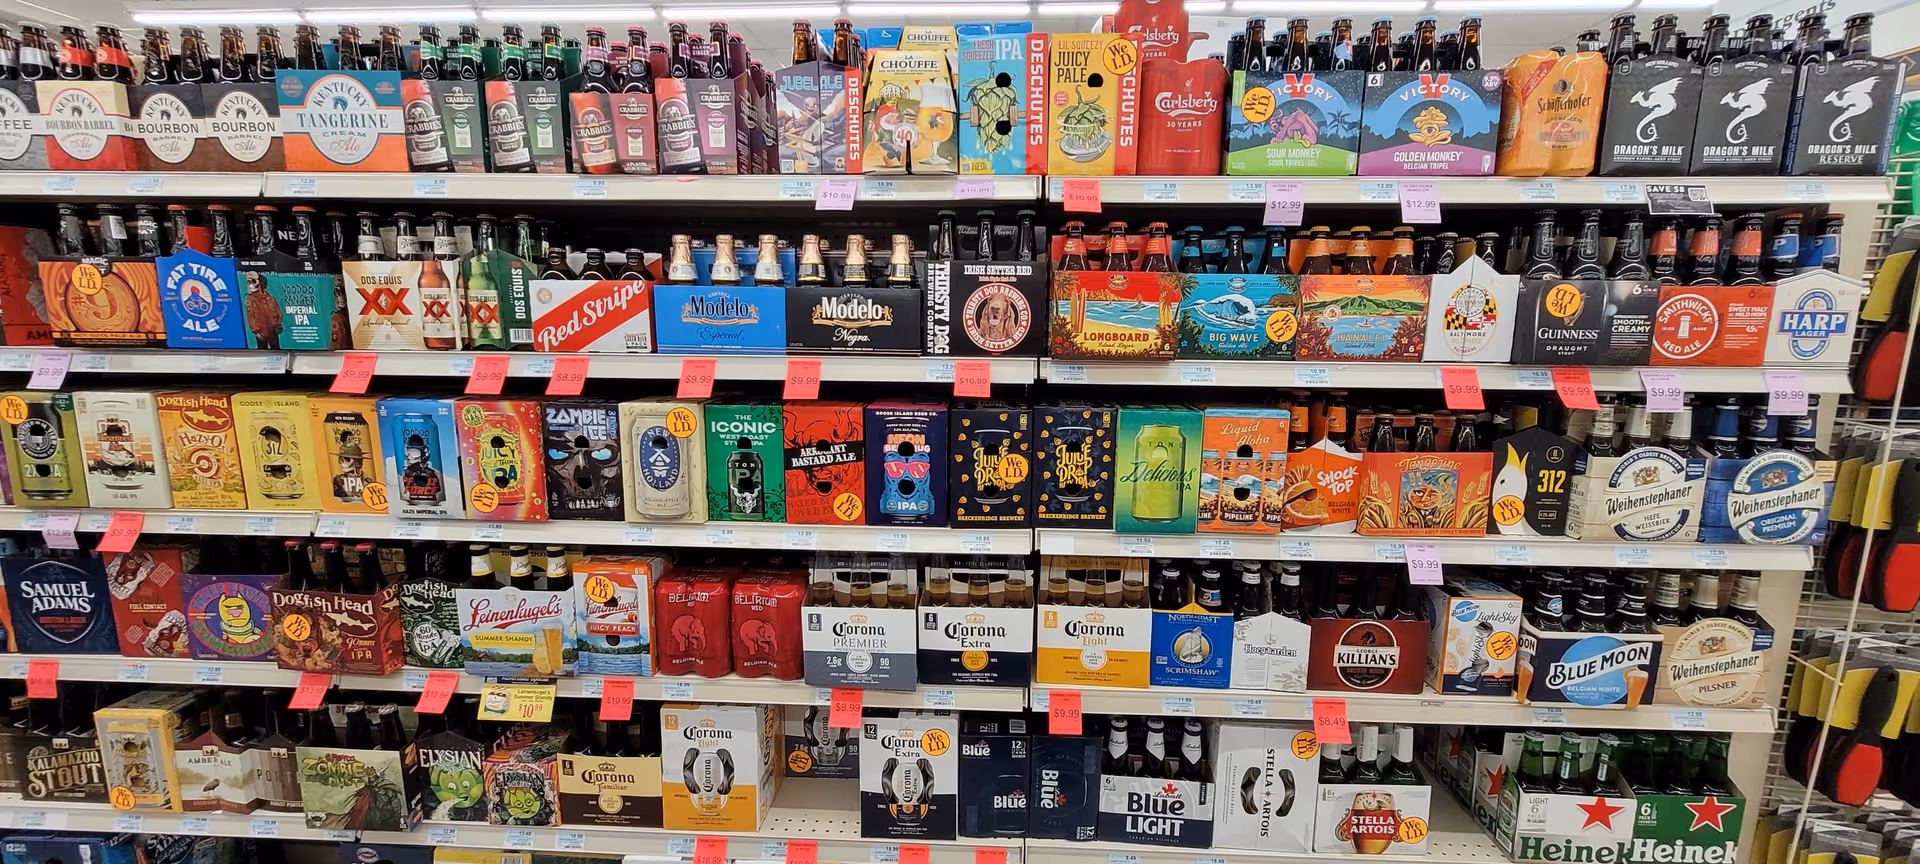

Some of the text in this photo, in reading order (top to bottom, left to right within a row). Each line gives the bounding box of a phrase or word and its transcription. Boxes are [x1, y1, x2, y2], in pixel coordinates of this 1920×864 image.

[907, 33, 950, 41] CHOUFFE
[973, 40, 994, 49] FRESH
[995, 39, 1023, 60] IPA
[1059, 40, 1103, 50] LIL SQUEEZY
[1108, 42, 1128, 56] We
[963, 50, 994, 61] SQUEEZED
[1054, 52, 1090, 67] JUICY
[881, 61, 938, 69] CHOUFFE
[1057, 67, 1086, 83] PALE
[780, 75, 842, 90] JUBEL ALE
[313, 81, 370, 108] KENTUCKY
[1031, 39, 1044, 145] DESCHUTES
[1399, 84, 1471, 102] VICTORY
[1155, 92, 1218, 112] Carlsberg
[296, 112, 388, 128] TANGERINE
[849, 77, 860, 160] DESCHUTES
[45, 120, 115, 130] BOURBON BARREL
[138, 123, 199, 133] BOURBON
[212, 122, 275, 132] BOURBON
[1614, 145, 1684, 154] DRAGON'S MILK
[1703, 146, 1774, 156] DRAGON'S MILK
[1808, 144, 1878, 154] DRAGON'S MILK
[1394, 151, 1463, 162] GOLDEN MONKEY
[1819, 155, 1864, 164] RESERVE
[822, 191, 851, 199] $10.99
[1271, 200, 1300, 210] $12.99
[1406, 200, 1436, 208] $12.99
[81, 258, 109, 266] MAGIC
[80, 268, 95, 279] We
[964, 266, 986, 276] IRISH
[987, 266, 1014, 276] SETTER
[166, 263, 227, 292] FAT TIRE
[361, 275, 403, 285] DOS EQUIS
[282, 284, 314, 295] VOODOO
[284, 295, 316, 305] RANGER
[355, 288, 414, 315] XX
[968, 290, 984, 318] THIRSTY
[985, 285, 998, 294] DOG
[1000, 286, 1025, 310] BREWING
[286, 306, 318, 315] IMPERIAL
[690, 296, 749, 318] Modelo
[822, 296, 883, 320] Modelo
[935, 262, 950, 354] THIRSTY DOG
[294, 315, 310, 325] IPA
[538, 280, 645, 351] Red Stripe
[1783, 313, 1847, 330] HARP
[183, 319, 220, 332] ALE
[1612, 325, 1651, 333] CREAMY
[968, 326, 1025, 349] IRISH SETTER RED
[1084, 332, 1149, 342] LONGBOARD
[1209, 333, 1259, 342] BIG WAVE
[1337, 333, 1386, 342] HANALEI
[1538, 327, 1598, 339] GUINNESS
[1795, 330, 1826, 338] LAGER
[1662, 340, 1702, 353] RED ALE
[37, 367, 64, 376] $9.99
[475, 372, 502, 381] $9.99
[685, 375, 711, 383] $9.99
[791, 377, 818, 385] $9.99
[959, 377, 988, 386] $10.99
[1449, 384, 1479, 394] $9.99
[1562, 386, 1591, 396] $9.99
[1650, 387, 1681, 398] $9.99
[1774, 390, 1804, 400] $9.99
[157, 396, 228, 409] Dogfish Head
[545, 408, 607, 425] ZOMBIE
[673, 412, 690, 422] We
[582, 425, 607, 441] ICE
[711, 421, 777, 433] ICONIC
[1220, 422, 1259, 437] Liquid
[887, 434, 926, 445] NEON
[791, 453, 856, 467] BASTARD ALE
[1006, 458, 1023, 467] We
[1395, 456, 1464, 473] Tangerine
[1119, 458, 1198, 484] Delicious
[1316, 465, 1359, 485] SHOCK
[343, 478, 362, 492] IPA
[1329, 479, 1354, 496] TOP
[1537, 470, 1565, 494] 312
[897, 501, 917, 511] IPA
[1606, 485, 1693, 516] Weihenstephaner
[1731, 485, 1820, 518] Weihenstephaner
[1224, 512, 1254, 521] PIPELINE
[1644, 512, 1660, 522] HEFE
[1760, 513, 1797, 526] ORIGINAL
[1634, 518, 1671, 530] WEISSBIER
[1762, 521, 1796, 533] PREMIUM
[110, 529, 138, 538] $9.99
[1412, 560, 1439, 569] $9.99
[20, 580, 95, 599] SAMUEL
[403, 582, 448, 593] Dogfish
[424, 589, 455, 599] Head
[32, 596, 92, 613] ADAMS
[273, 591, 330, 613] Dogfish
[334, 598, 374, 615] Head
[735, 594, 778, 607] DELIRIUM
[463, 598, 562, 631] Leinenkugel's
[833, 621, 885, 637] Corona
[944, 620, 1007, 640] Corona
[1064, 620, 1124, 639] Corona
[833, 638, 888, 649] PREMIER
[960, 638, 991, 648] Extra
[1082, 636, 1108, 647] Light
[1243, 643, 1297, 657] Hoegaarden
[1337, 652, 1397, 666] KILLIAN'S
[1165, 667, 1218, 676] SCRIMSHAW
[1549, 646, 1649, 685] BLUE MOON
[1671, 655, 1760, 681] Weihenstephaner
[1698, 681, 1738, 694] PILSNER
[606, 697, 631, 705] $10.99
[835, 703, 861, 713] $9.99
[1054, 708, 1080, 718] $9.99
[1319, 716, 1345, 726] $8.49
[683, 725, 732, 740] Corona
[962, 744, 990, 756] Blue
[28, 751, 100, 772] KALAMAZOO
[419, 749, 483, 768] ELYSIAN
[581, 769, 636, 783] Corona
[704, 759, 714, 792] Corona
[903, 769, 911, 803] Corona
[1040, 769, 1059, 809] Blue
[1260, 748, 1275, 838] STELLA ARTOIS
[993, 796, 1026, 809] Blue
[1127, 791, 1185, 816] Blue
[1529, 797, 1549, 805] LIGHT
[1125, 815, 1184, 836] LIGHT
[1351, 815, 1395, 825] STELLA
[1350, 824, 1395, 834] ARTOIS
[696, 855, 722, 863] $16.99
